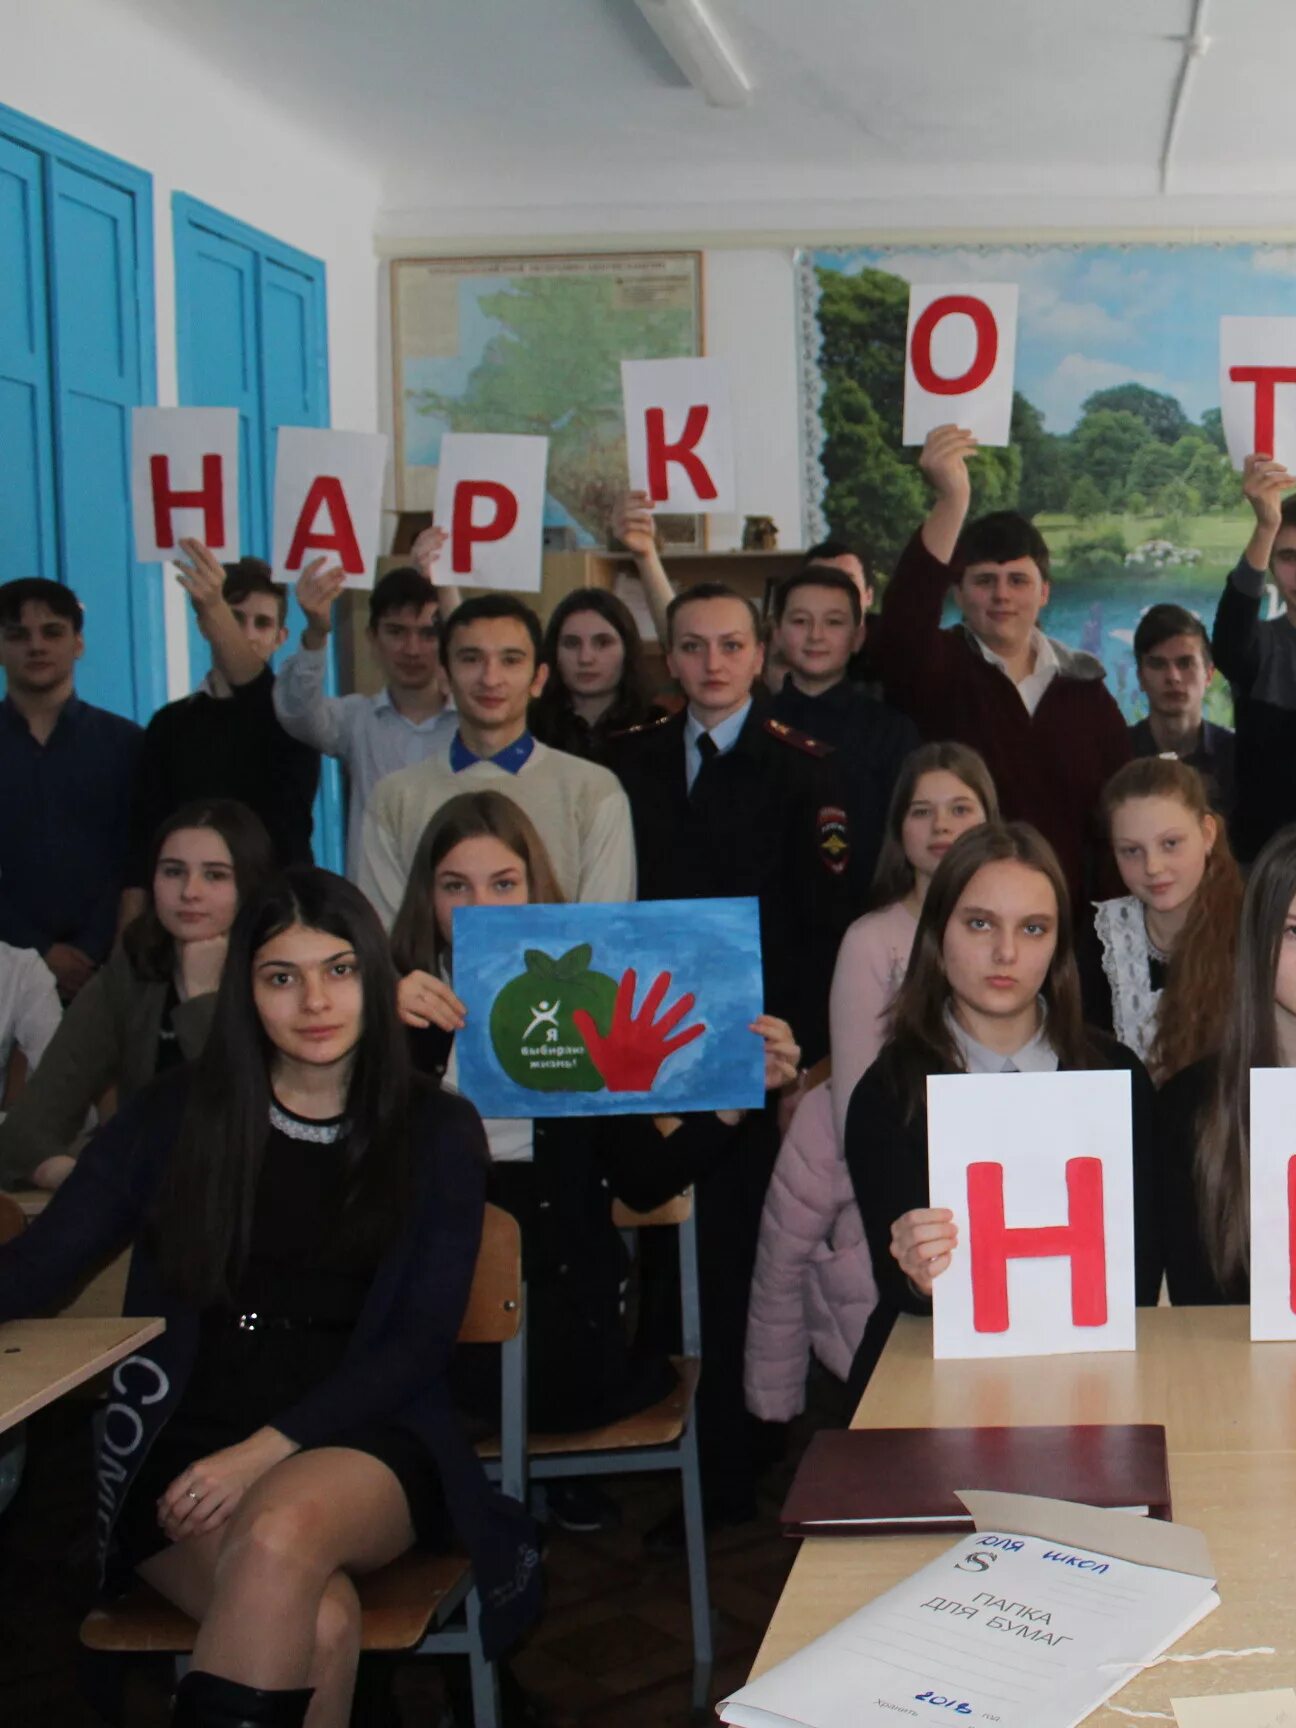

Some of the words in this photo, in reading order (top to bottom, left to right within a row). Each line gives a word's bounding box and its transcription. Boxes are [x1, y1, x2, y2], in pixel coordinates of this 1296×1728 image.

[150, 454, 225, 549] Н
[285, 476, 365, 575] А
[451, 480, 519, 574] Р
[644, 404, 718, 503] К
[909, 294, 999, 396] О
[967, 1155, 1109, 1335] Н
[919, 1596, 980, 1620] ДЛЯ
[985, 1616, 1074, 1647] БУМАГ
[972, 1592, 1052, 1626] ПАПКА
